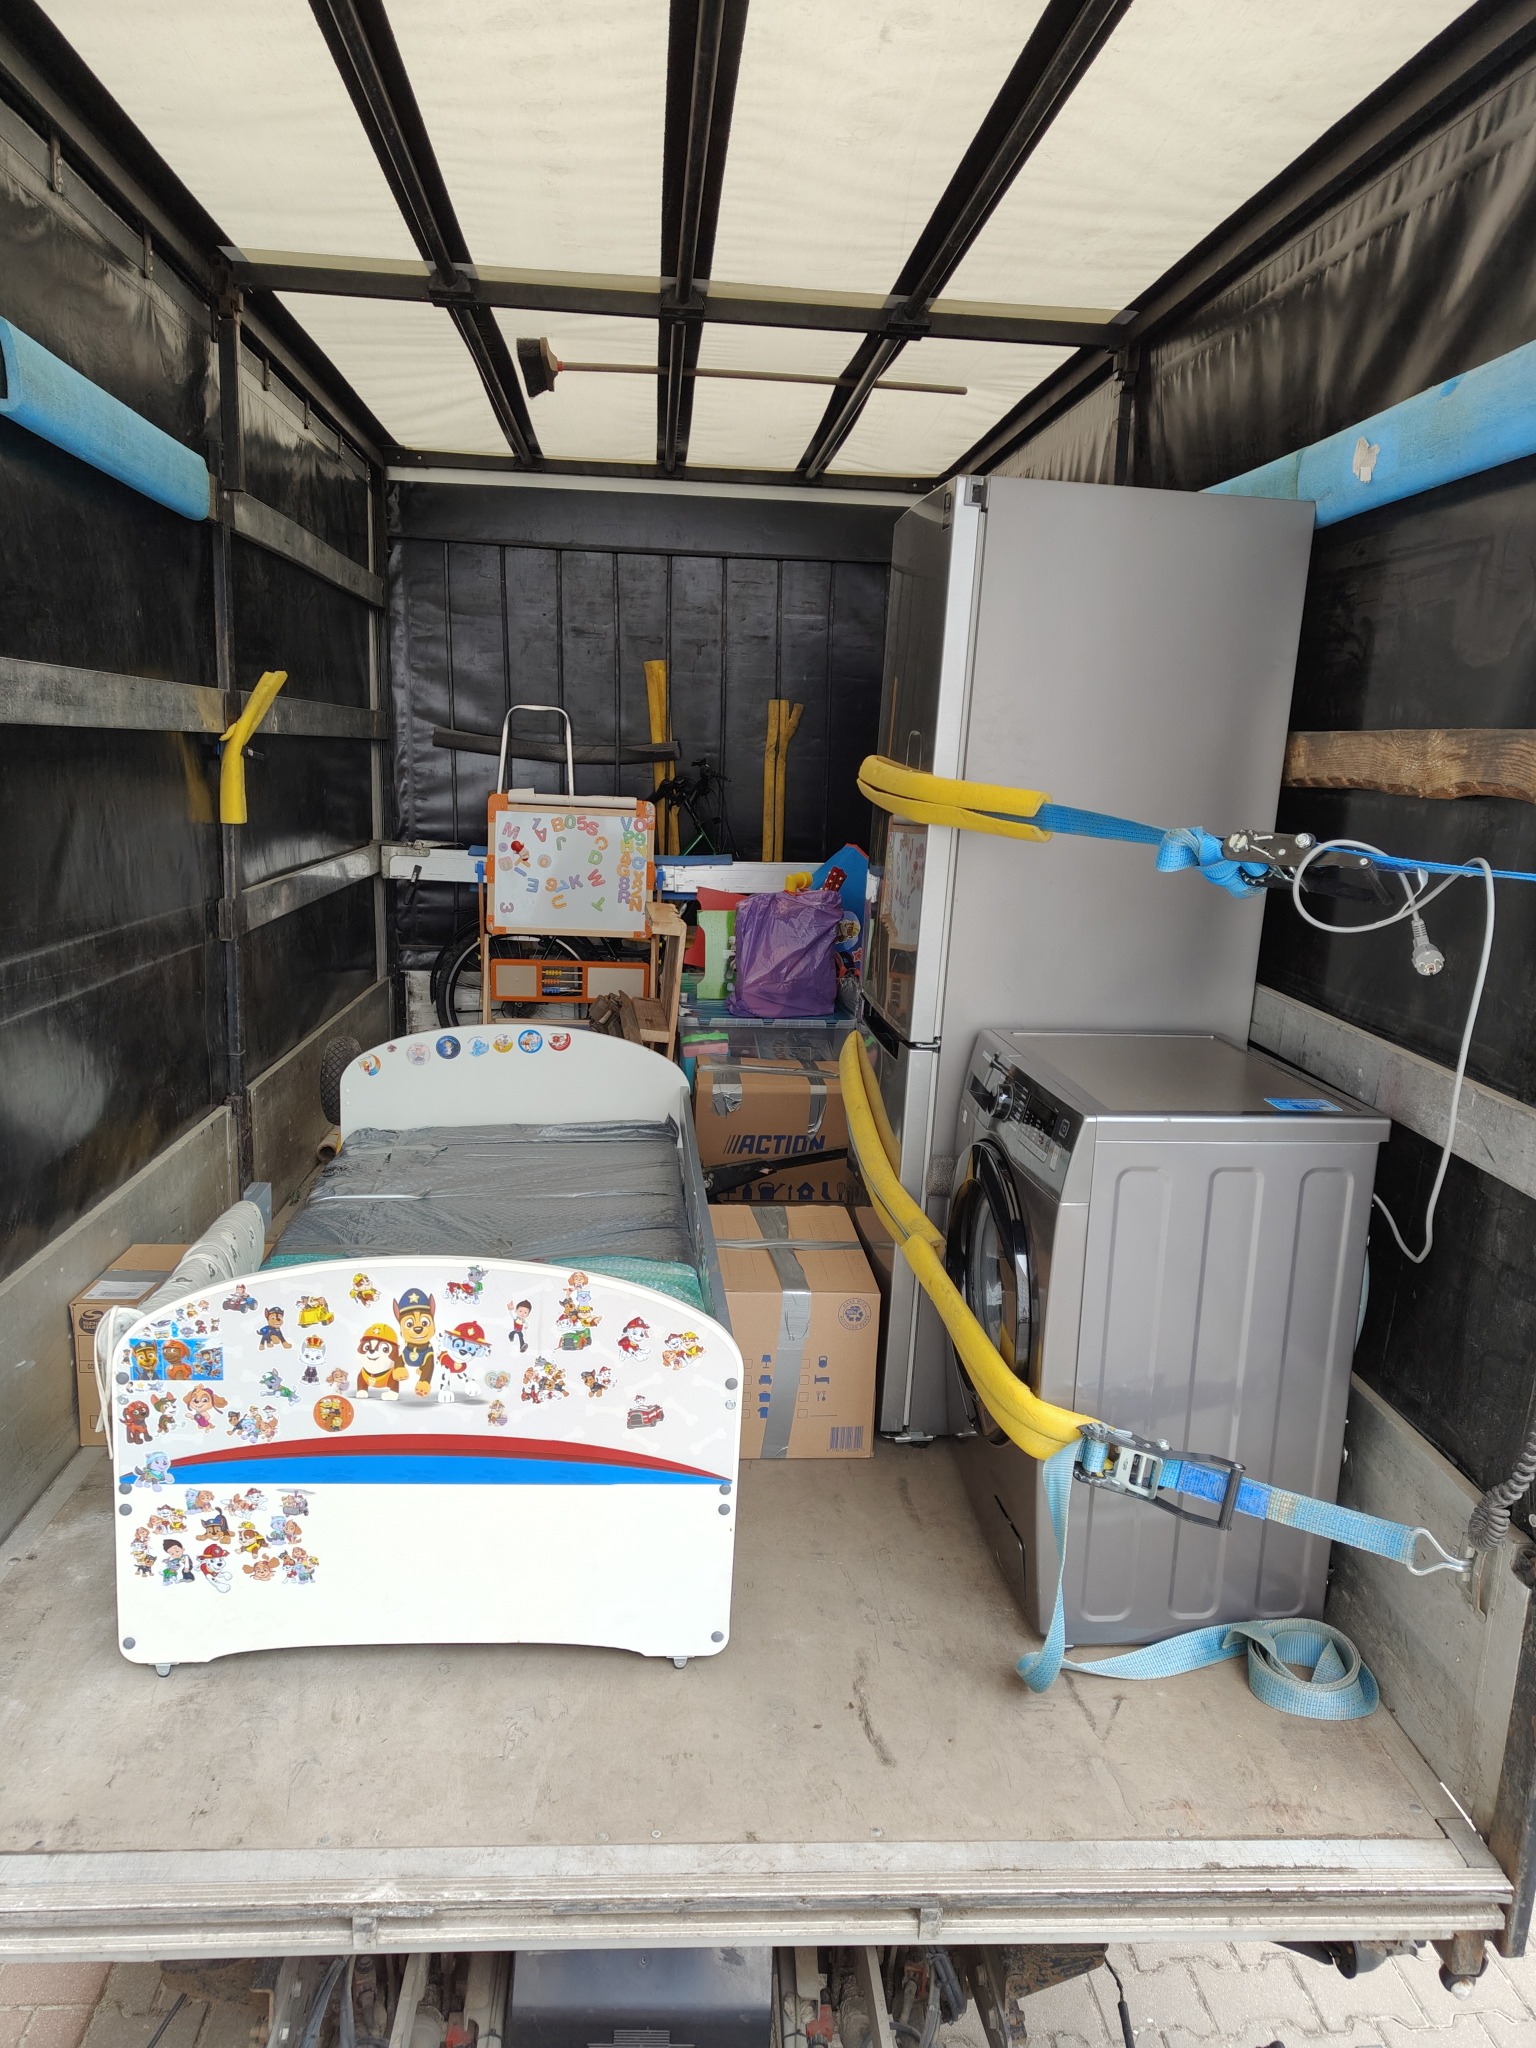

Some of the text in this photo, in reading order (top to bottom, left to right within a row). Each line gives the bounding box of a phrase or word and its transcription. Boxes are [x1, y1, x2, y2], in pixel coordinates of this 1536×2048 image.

[620, 816, 633, 831] V
[588, 849, 603, 865] D
[737, 1134, 826, 1154] ACTION
